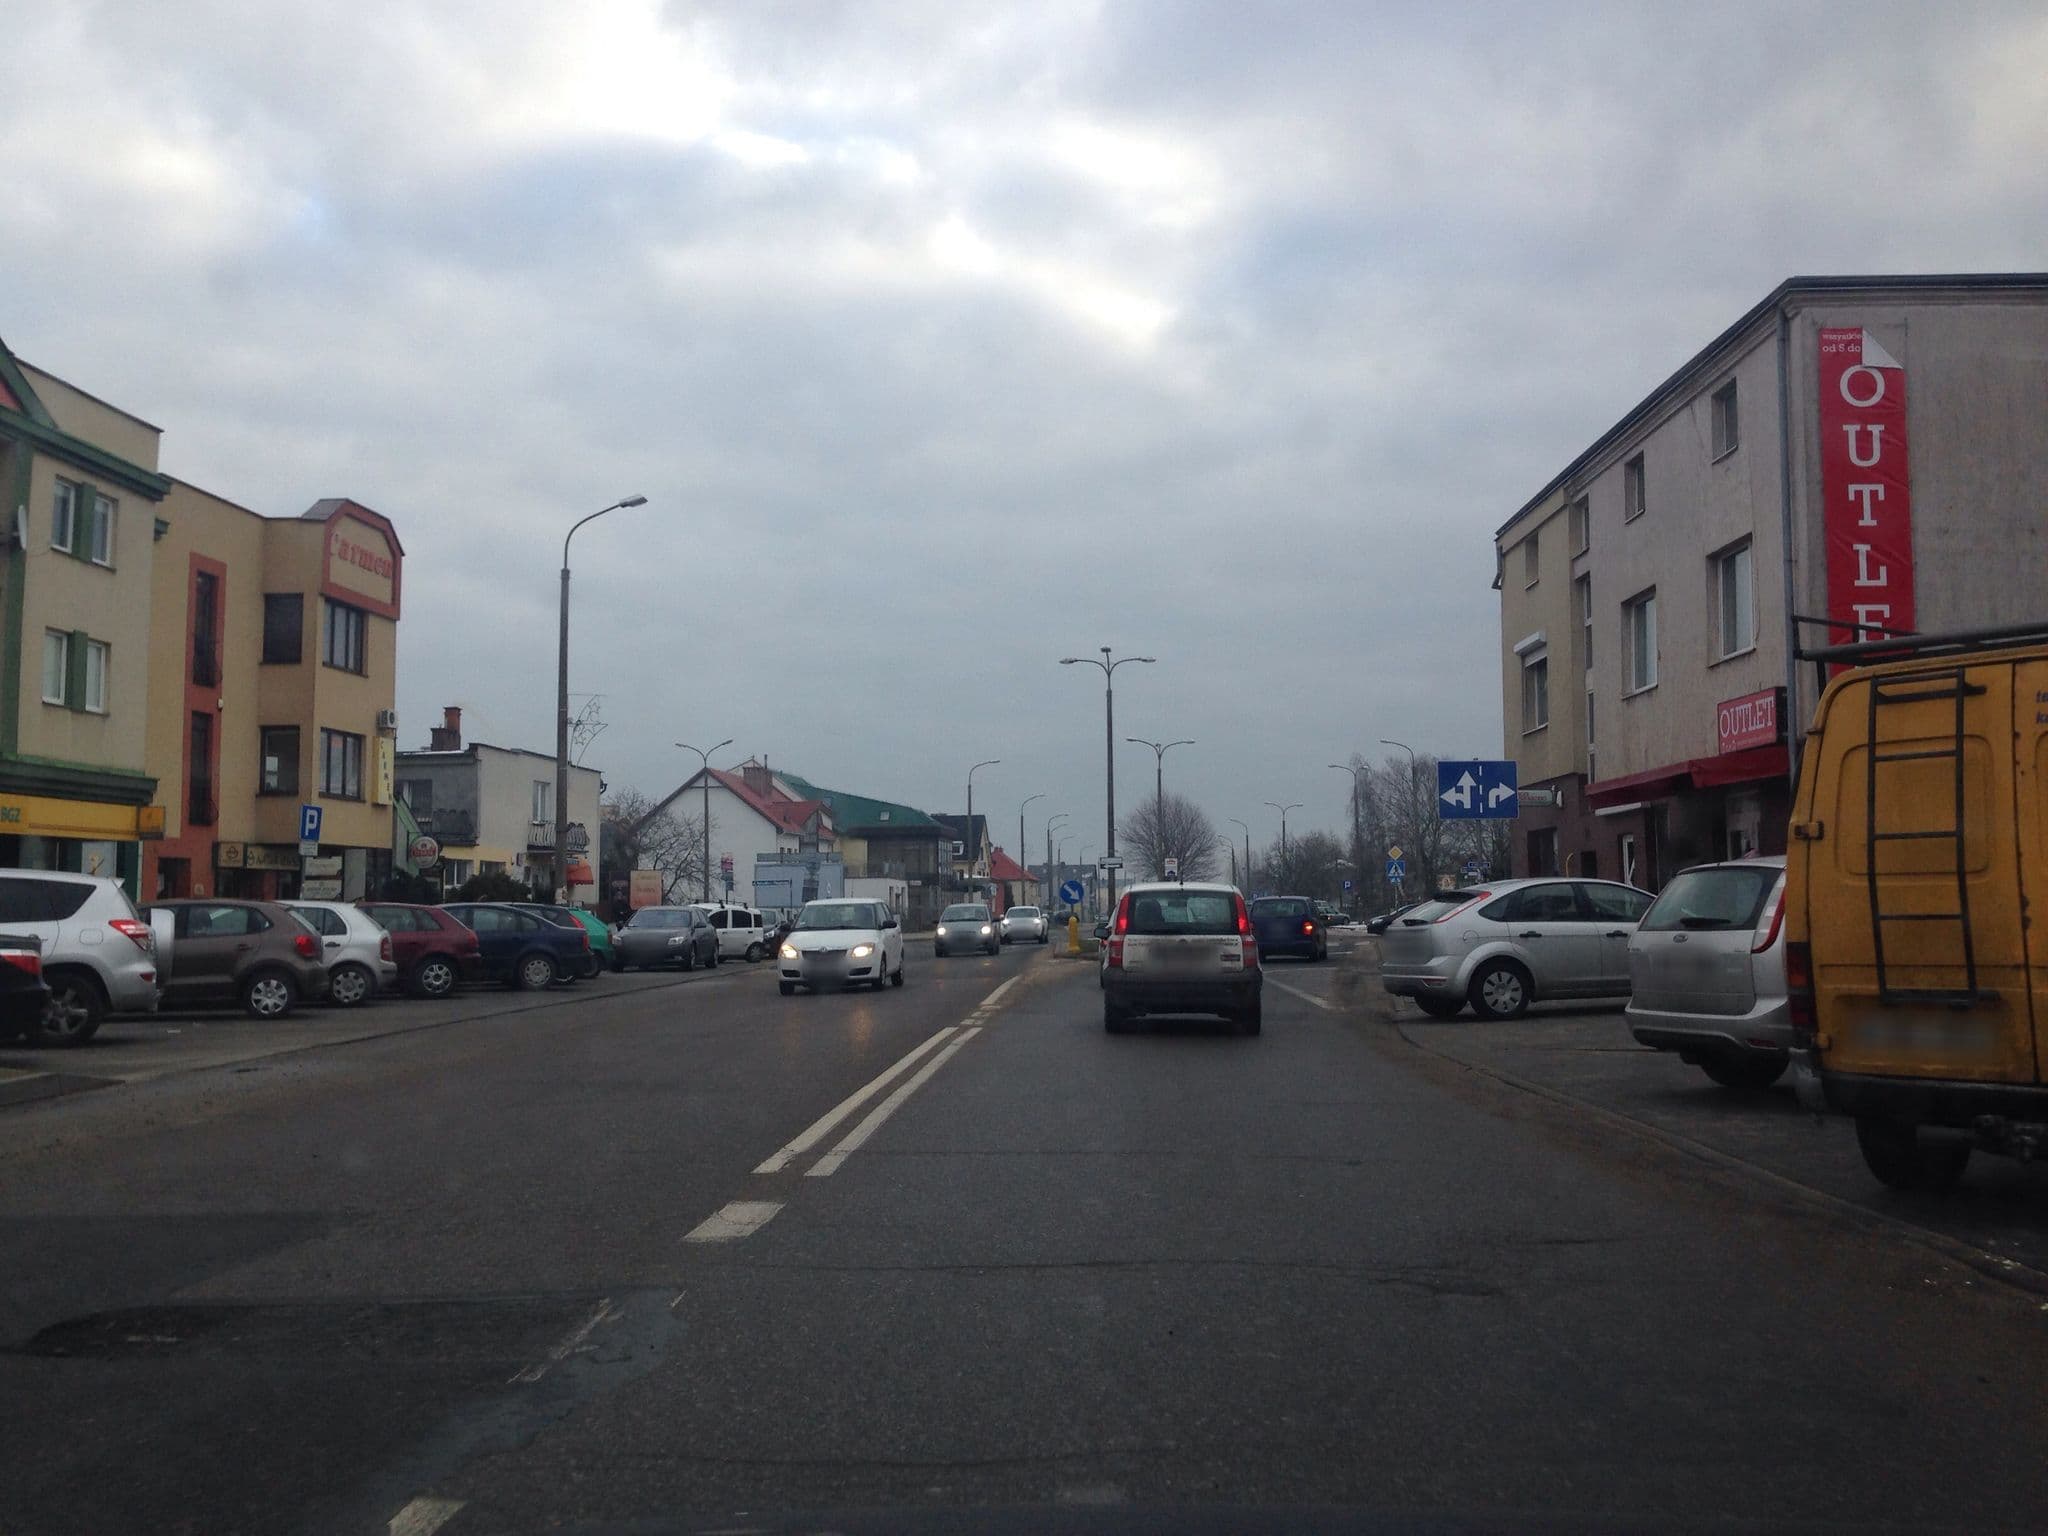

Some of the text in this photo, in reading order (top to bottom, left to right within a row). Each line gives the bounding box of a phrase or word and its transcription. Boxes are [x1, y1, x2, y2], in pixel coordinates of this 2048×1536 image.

[1822, 344, 1836, 353] od
[1847, 344, 1861, 353] do
[1720, 696, 1774, 738] OUTLET
[305, 808, 318, 836] P
